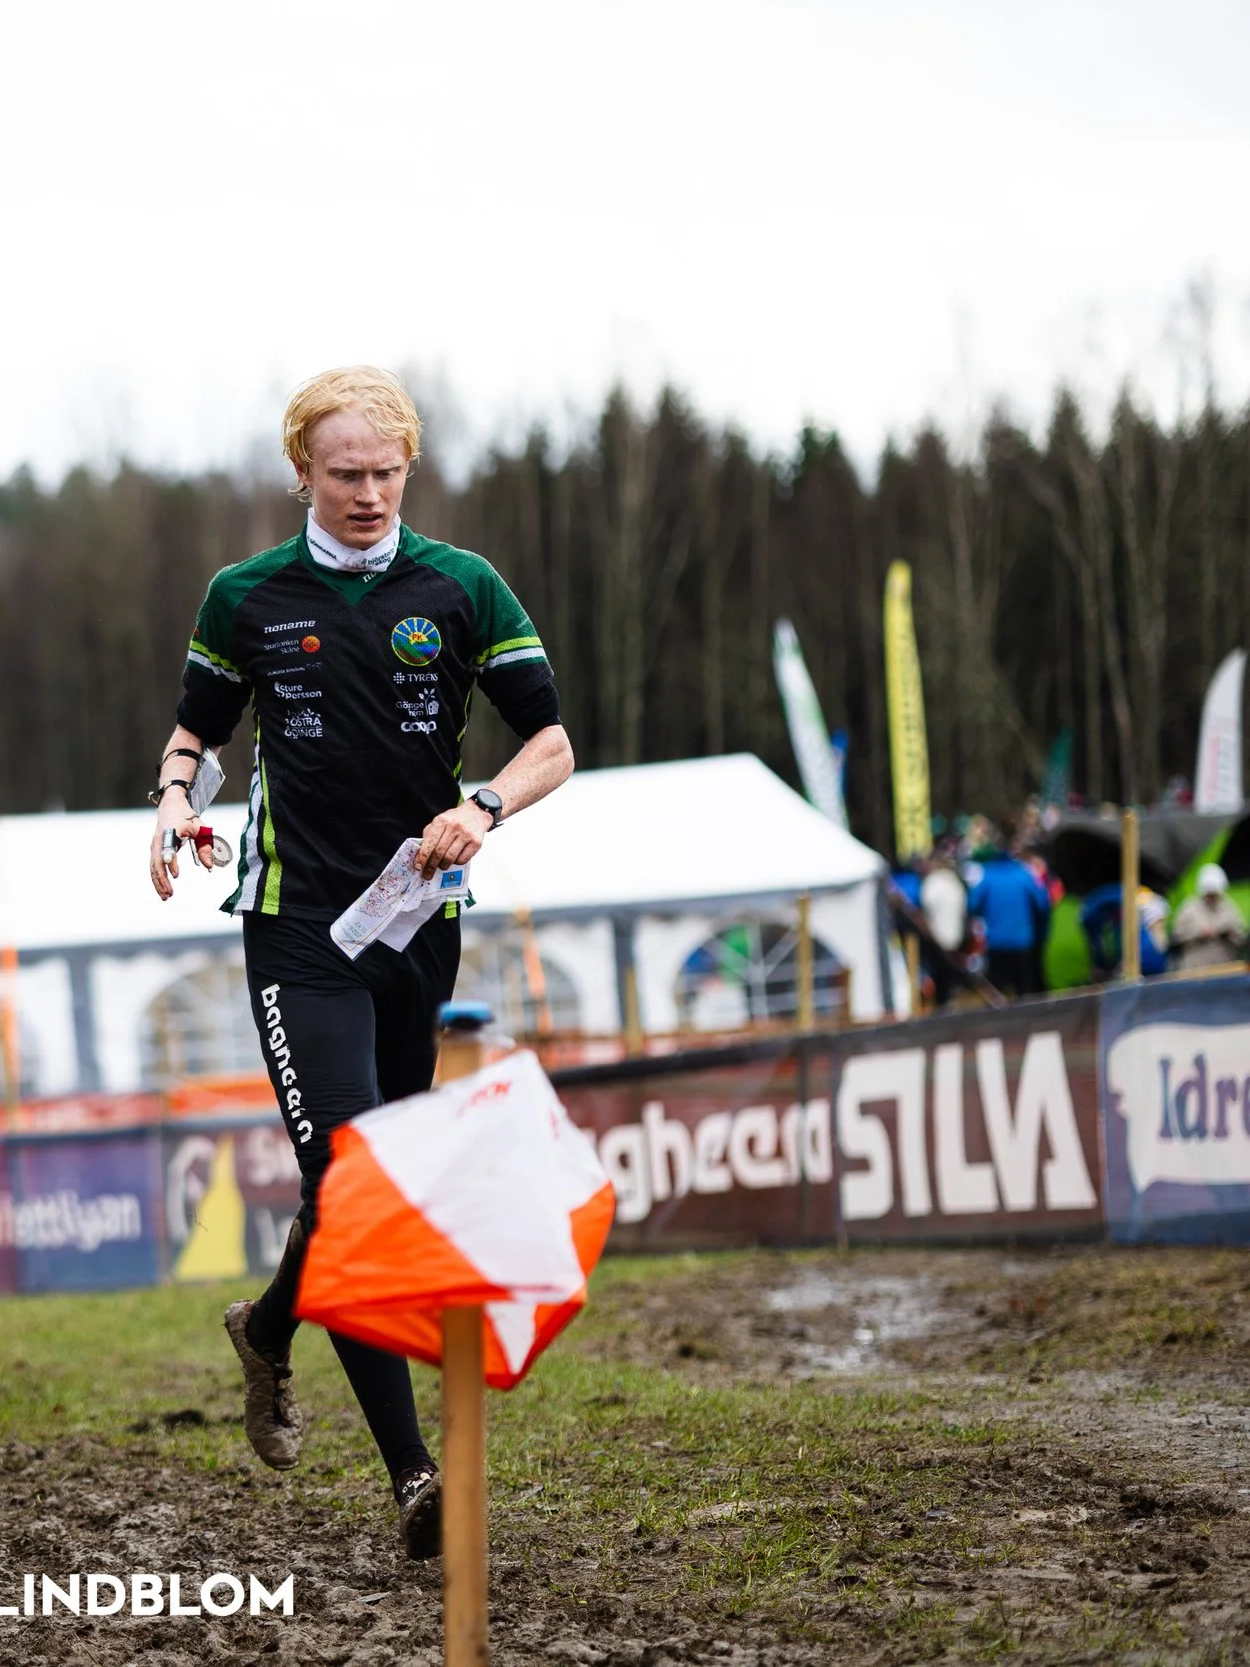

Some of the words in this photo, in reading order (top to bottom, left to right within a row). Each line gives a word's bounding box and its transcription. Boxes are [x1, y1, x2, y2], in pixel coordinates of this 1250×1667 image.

[264, 620, 316, 634] noname
[837, 1030, 1098, 1221] SILVA
[1158, 1052, 1250, 1139] Idr
[586, 1100, 834, 1225] gheera
